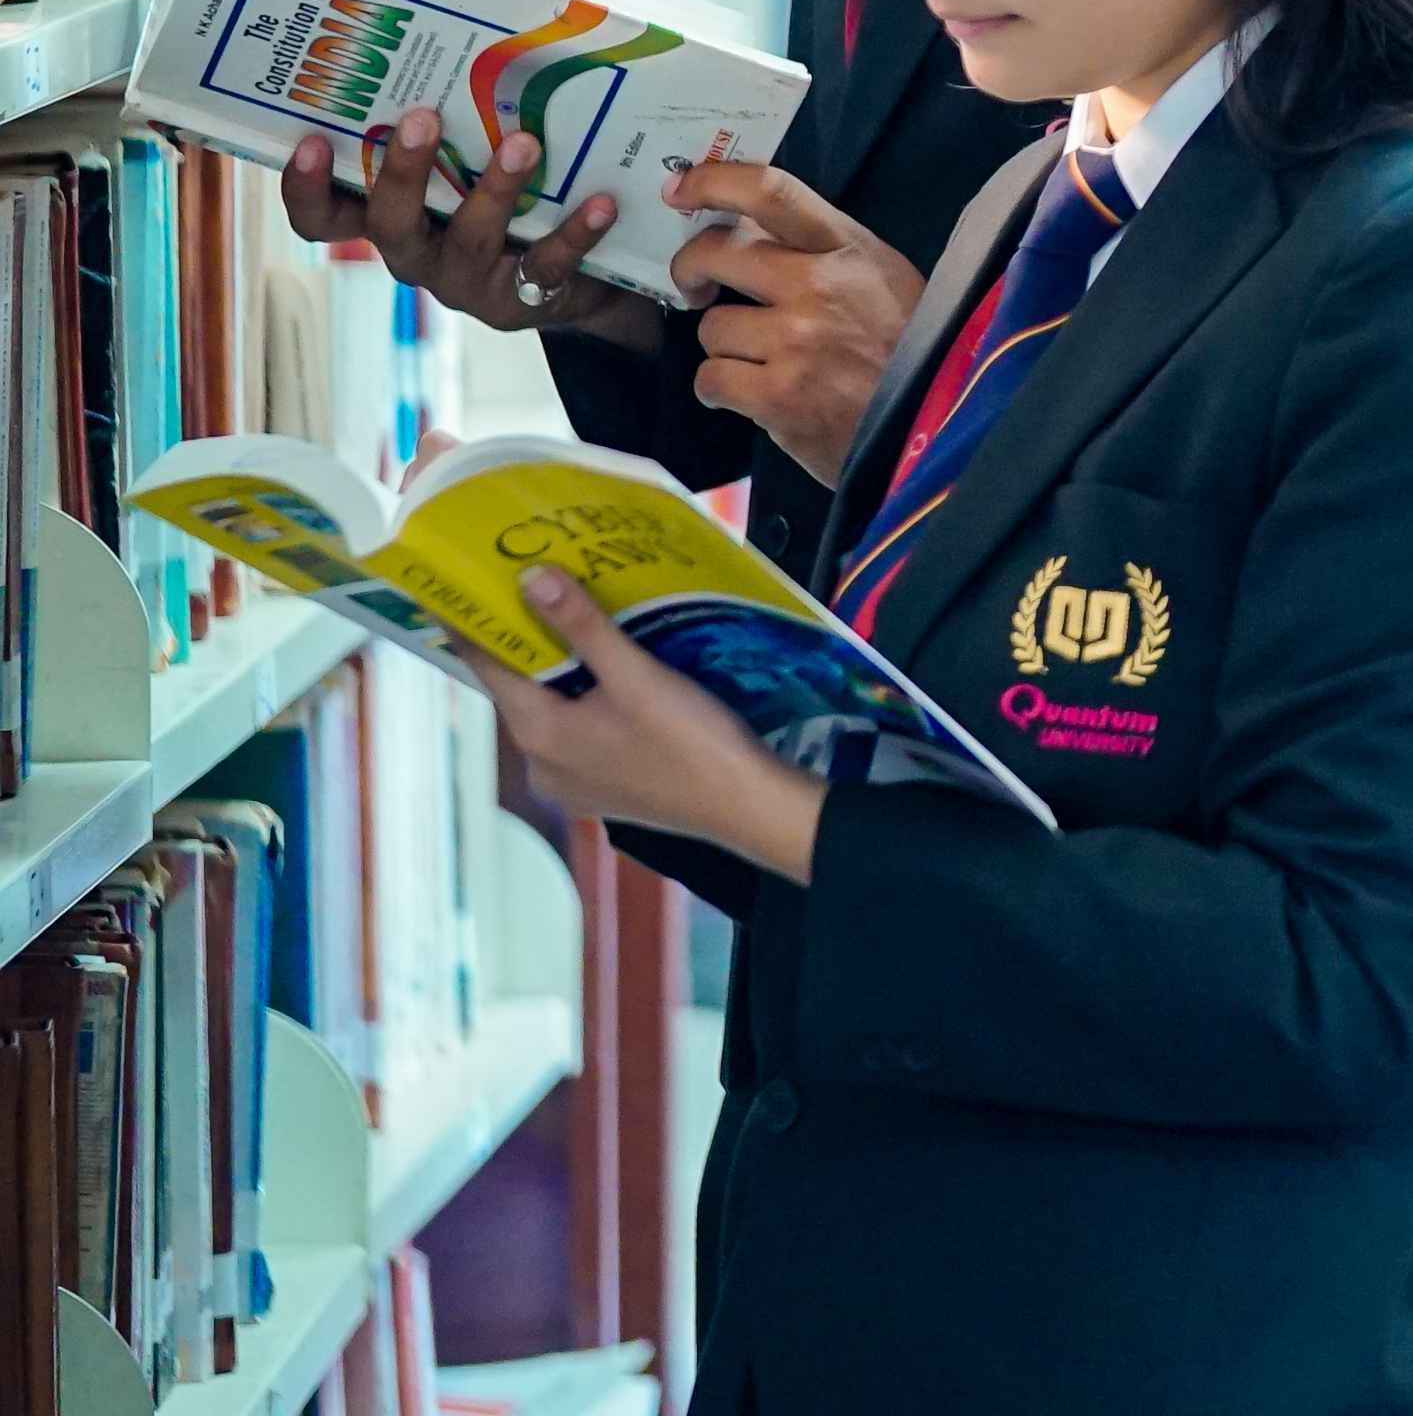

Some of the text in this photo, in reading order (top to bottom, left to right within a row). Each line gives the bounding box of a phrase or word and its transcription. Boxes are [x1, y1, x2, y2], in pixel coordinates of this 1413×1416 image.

[244, 13, 279, 43] The
[255, 3, 320, 96] Constitution
[496, 505, 666, 560] CYBER
[577, 540, 695, 584] AWS
[401, 561, 480, 618] CYBER
[1000, 683, 1158, 731] Quantum
[1038, 727, 1155, 756] UNIVERSITY
